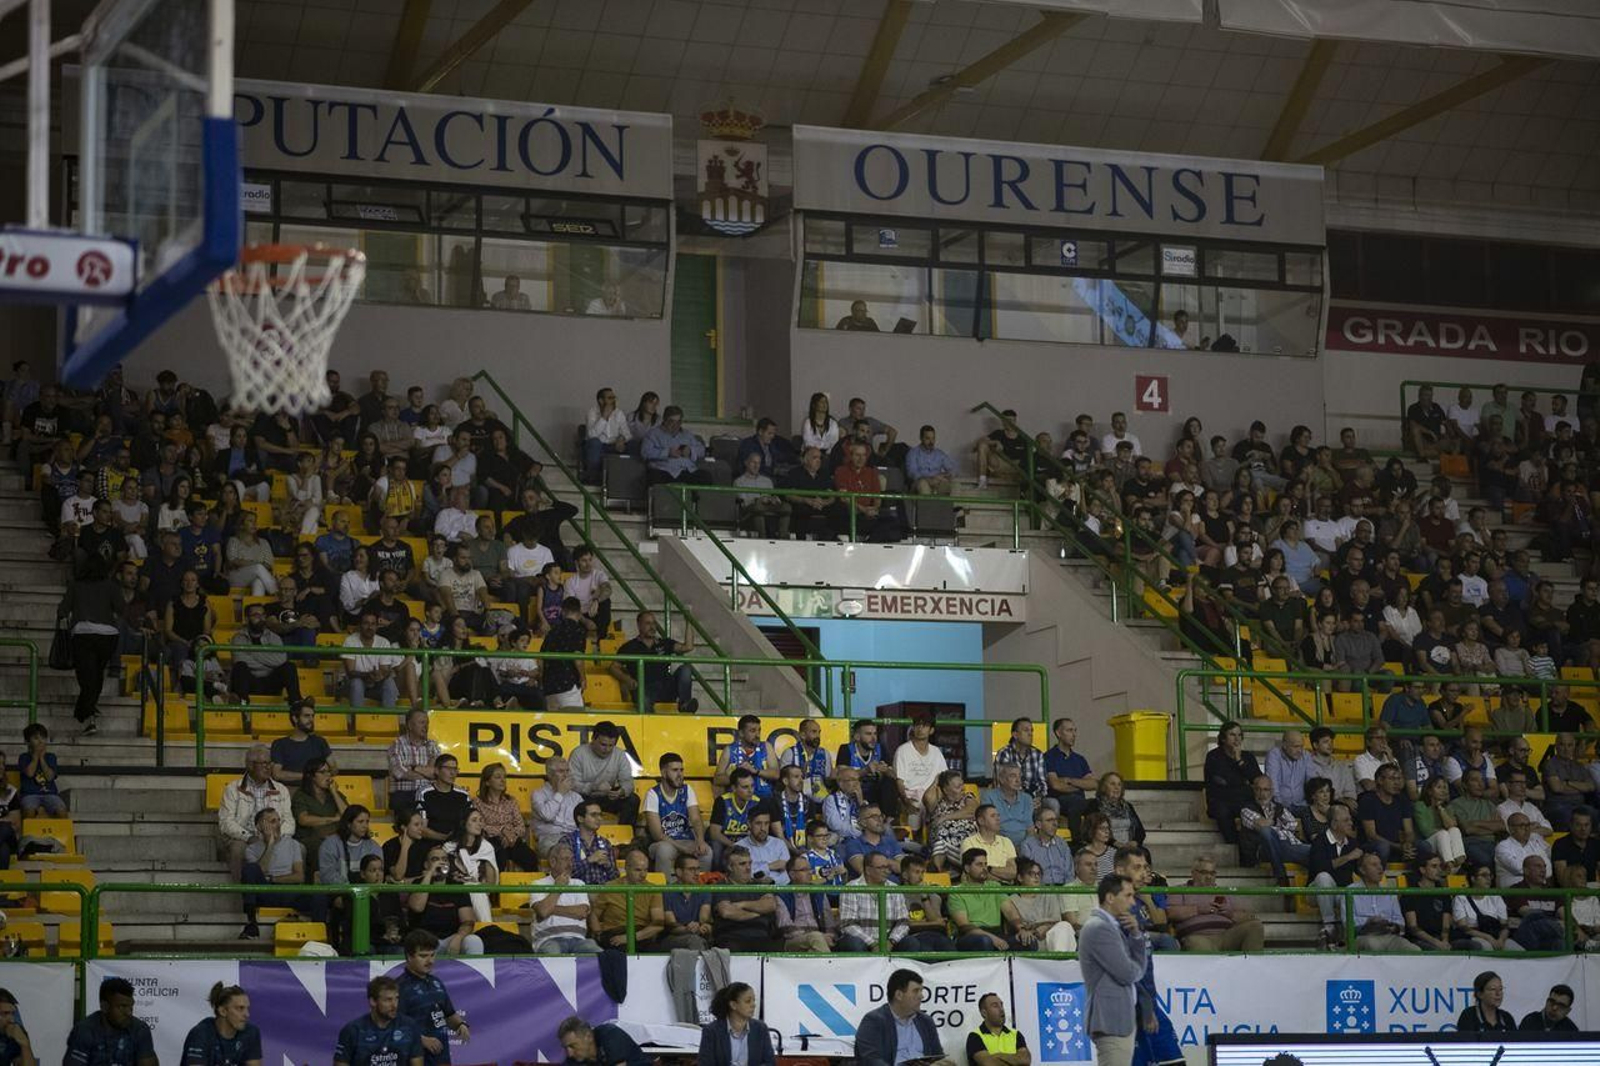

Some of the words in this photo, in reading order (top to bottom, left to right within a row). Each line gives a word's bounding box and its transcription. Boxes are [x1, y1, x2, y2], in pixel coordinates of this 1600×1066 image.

[233, 92, 631, 182] PUTACIÓN
[853, 144, 1266, 228] OURENSE
[244, 190, 271, 200] radio
[0, 250, 50, 278] ro
[1342, 316, 1498, 352] GRADA
[1518, 327, 1590, 358] RIO
[1142, 379, 1162, 409] 4
[866, 593, 1014, 618] EMERXENCIA
[869, 984, 978, 1004] DORTE
[1156, 987, 1216, 1014] NTA
[1389, 987, 1476, 1014] XUNT
